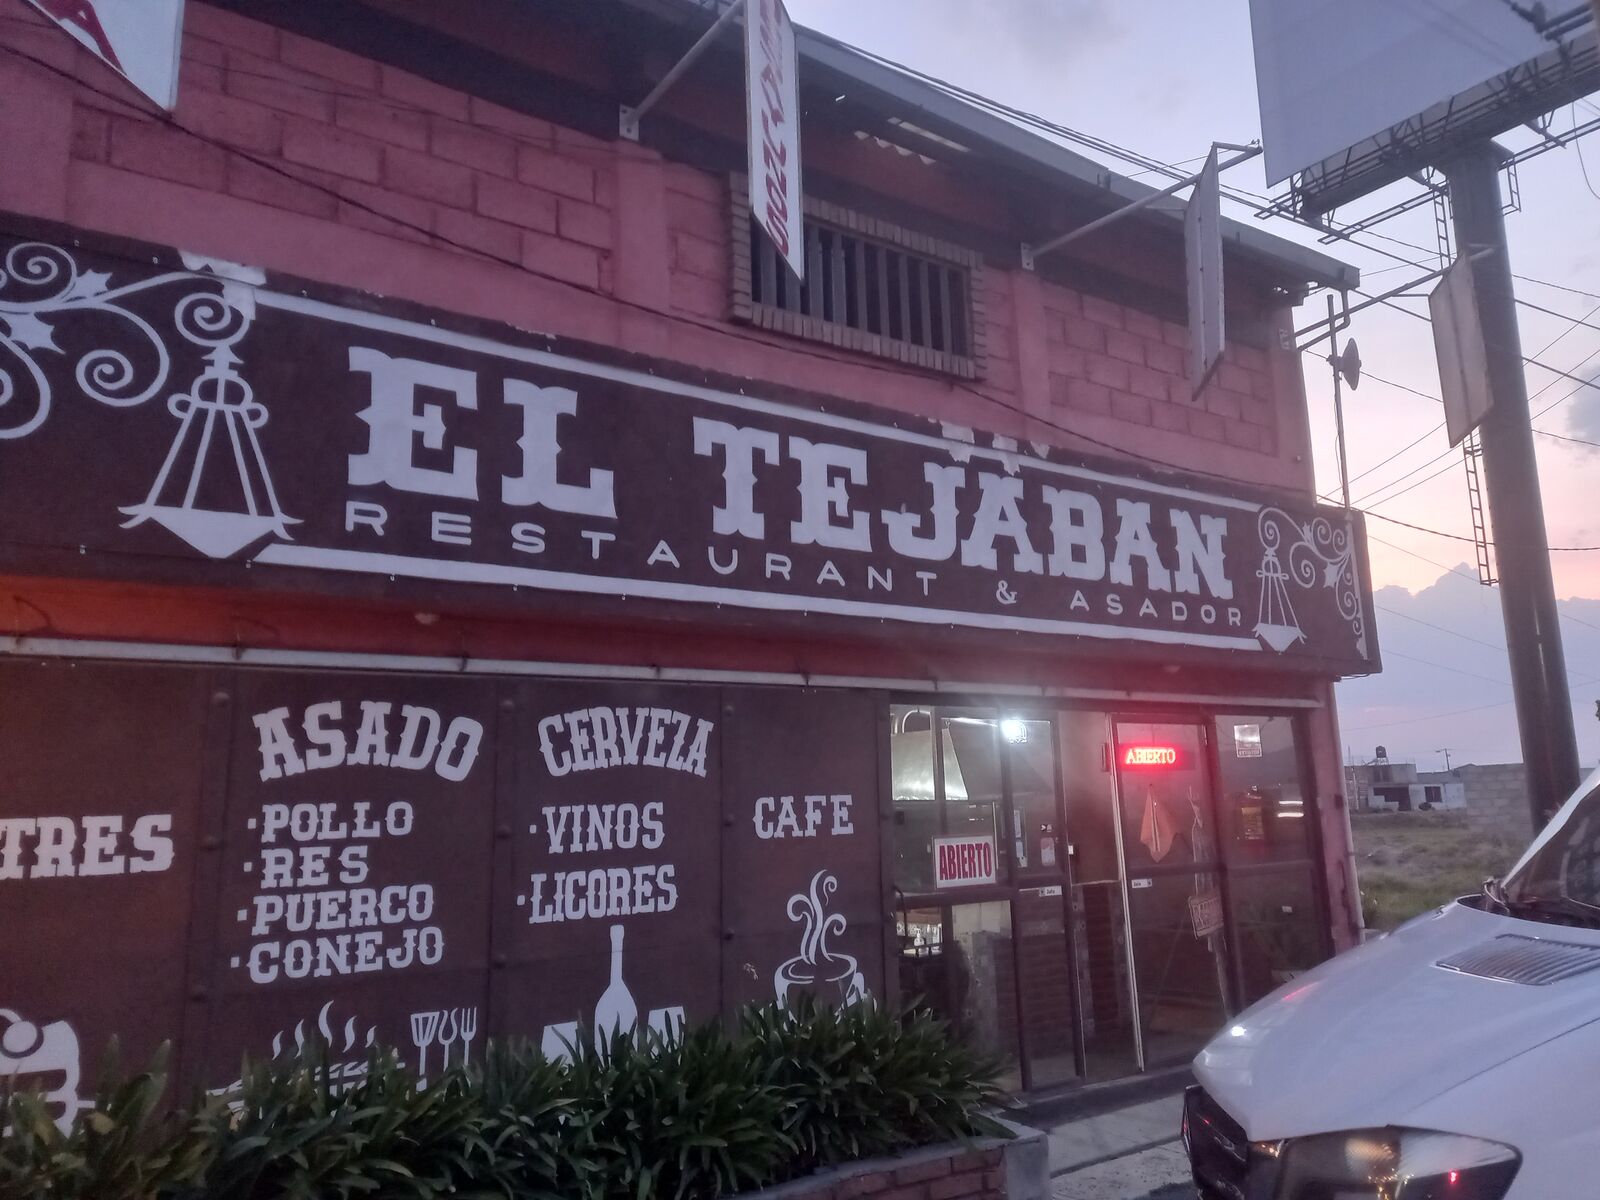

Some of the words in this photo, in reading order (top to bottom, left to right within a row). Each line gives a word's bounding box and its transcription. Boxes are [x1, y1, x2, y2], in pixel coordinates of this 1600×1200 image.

[347, 346, 618, 519] EL
[693, 416, 1233, 600] TEJABAN
[345, 501, 937, 596] RESTAURANT
[996, 580, 1017, 604] &
[1069, 590, 1242, 626] ASADOR
[252, 700, 484, 782] ASADO
[539, 706, 714, 778] CERVEZA
[1125, 747, 1176, 764] ABIERTO
[261, 801, 414, 843] POLLO
[542, 802, 665, 854] VINOS
[752, 794, 854, 839] CAFE
[260, 845, 369, 889] RES
[939, 842, 992, 881] ABIERTO
[251, 884, 434, 936] PUERCO
[529, 864, 678, 924] LICORES
[247, 926, 445, 984] CONEJO
